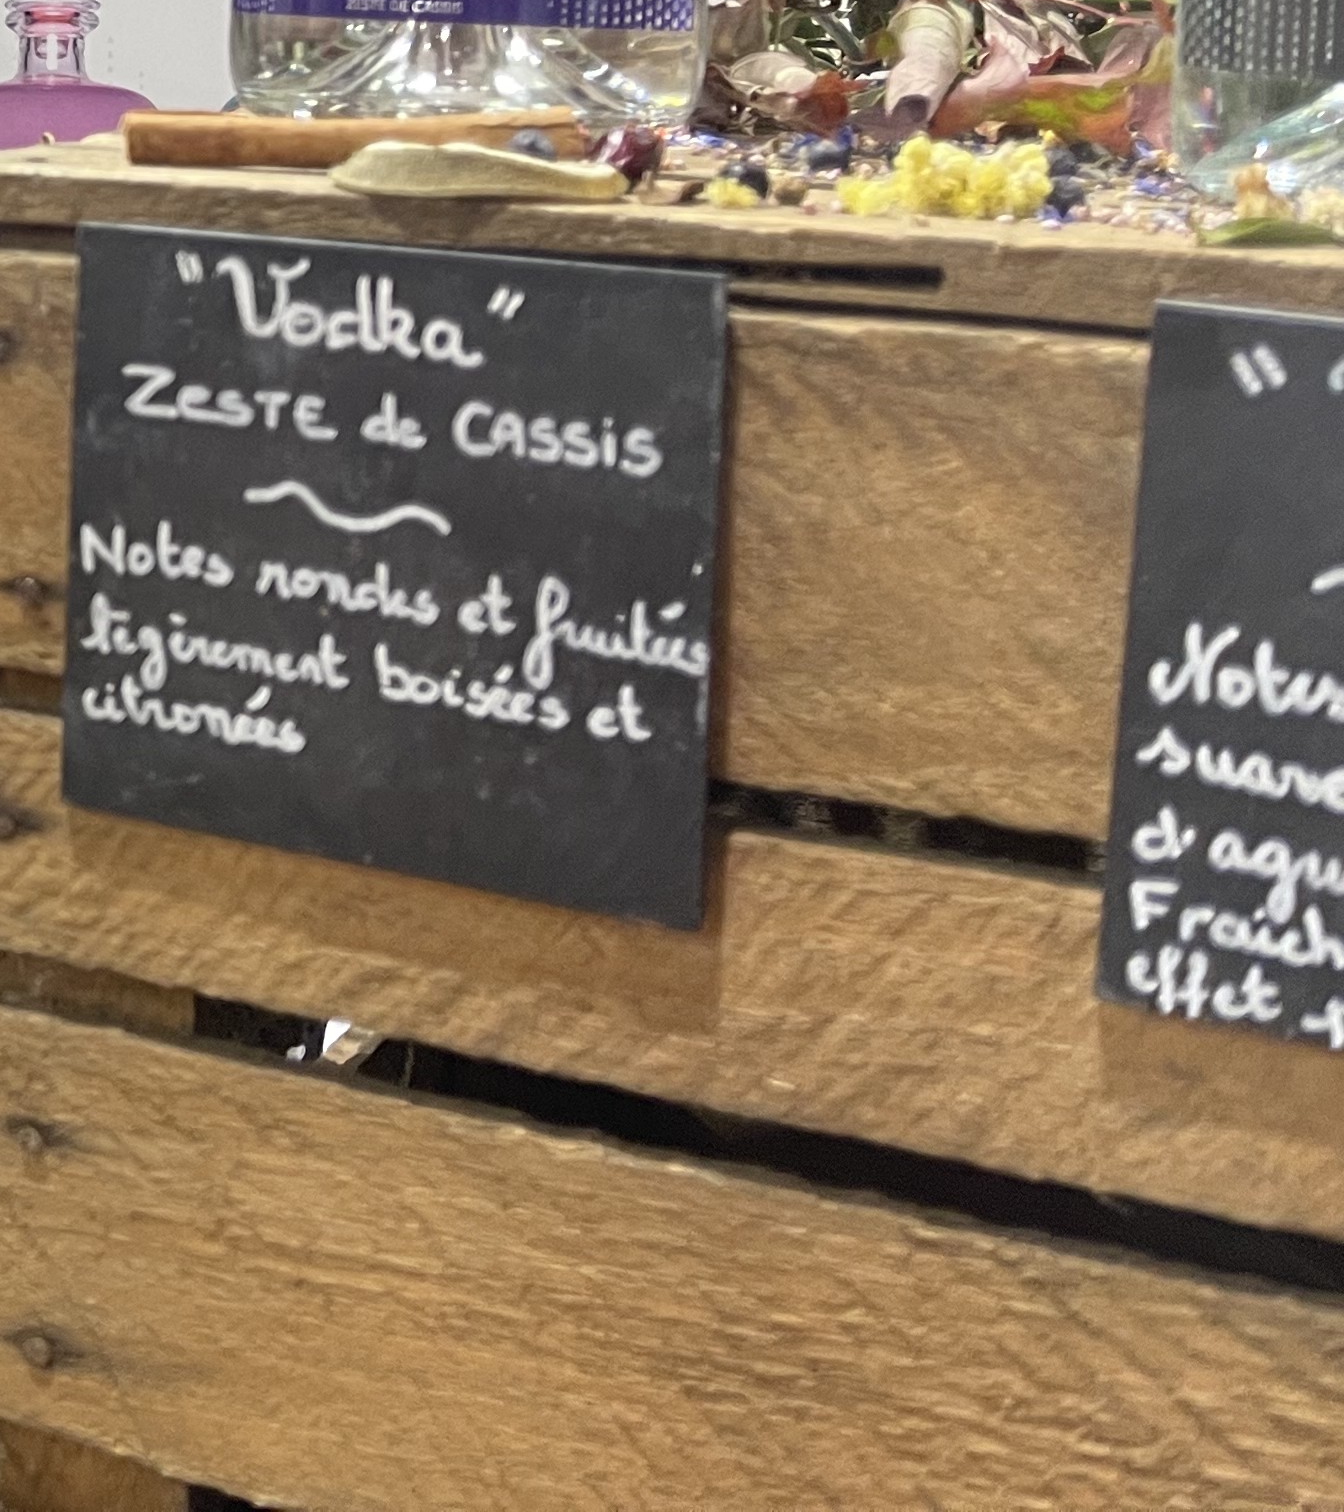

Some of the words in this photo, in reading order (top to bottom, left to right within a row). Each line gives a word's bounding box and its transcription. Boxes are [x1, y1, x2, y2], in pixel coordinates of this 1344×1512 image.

[361, 392, 427, 450] de
[80, 520, 234, 587] Notes
[458, 572, 516, 635] et
[374, 642, 571, 730] boisées
[586, 684, 653, 742] et
